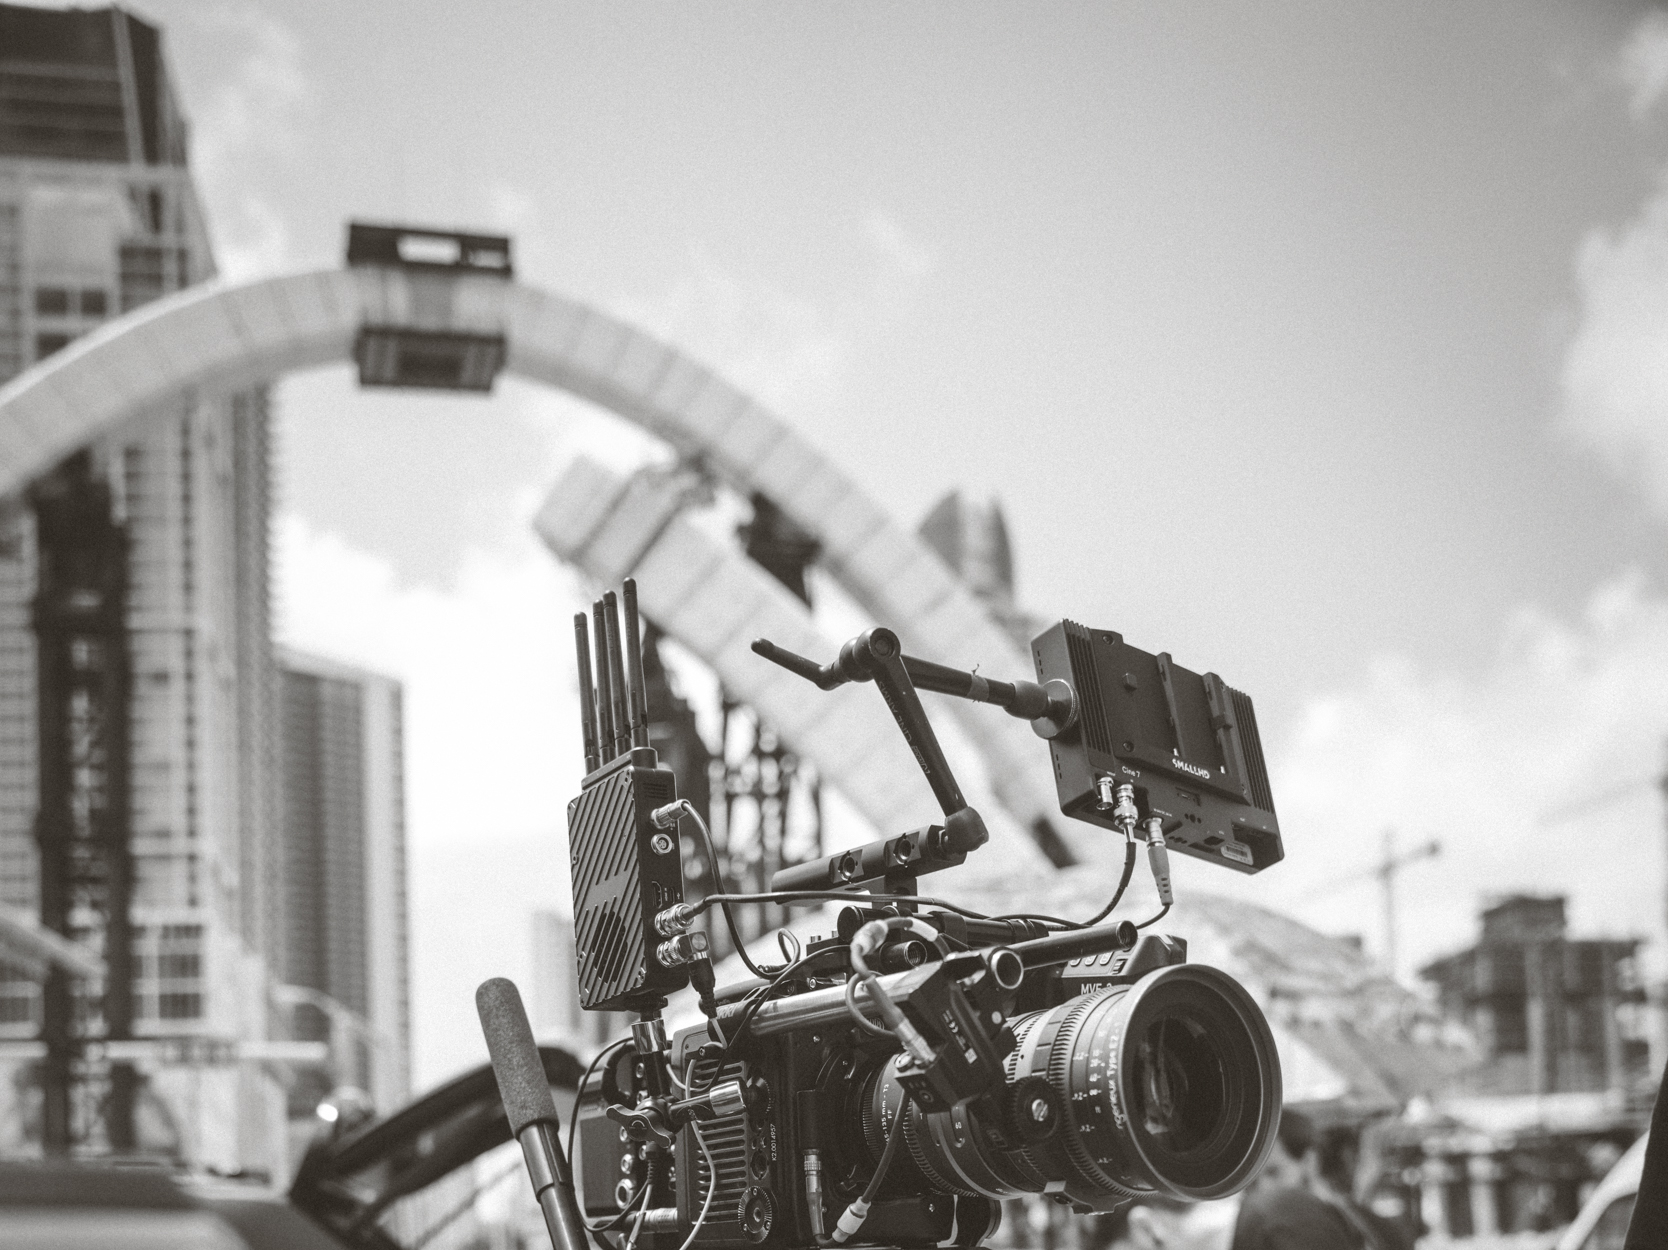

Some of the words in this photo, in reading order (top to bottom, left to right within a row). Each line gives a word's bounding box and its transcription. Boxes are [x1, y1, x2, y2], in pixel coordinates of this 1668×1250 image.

[1121, 765, 1136, 777] Cine
[1136, 770, 1141, 778] 7
[1172, 758, 1210, 779] SMALLHD
[1081, 983, 1112, 995] MVF
[1107, 1051, 1117, 1077] Type
[1108, 1079, 1127, 1130] ngenieux
